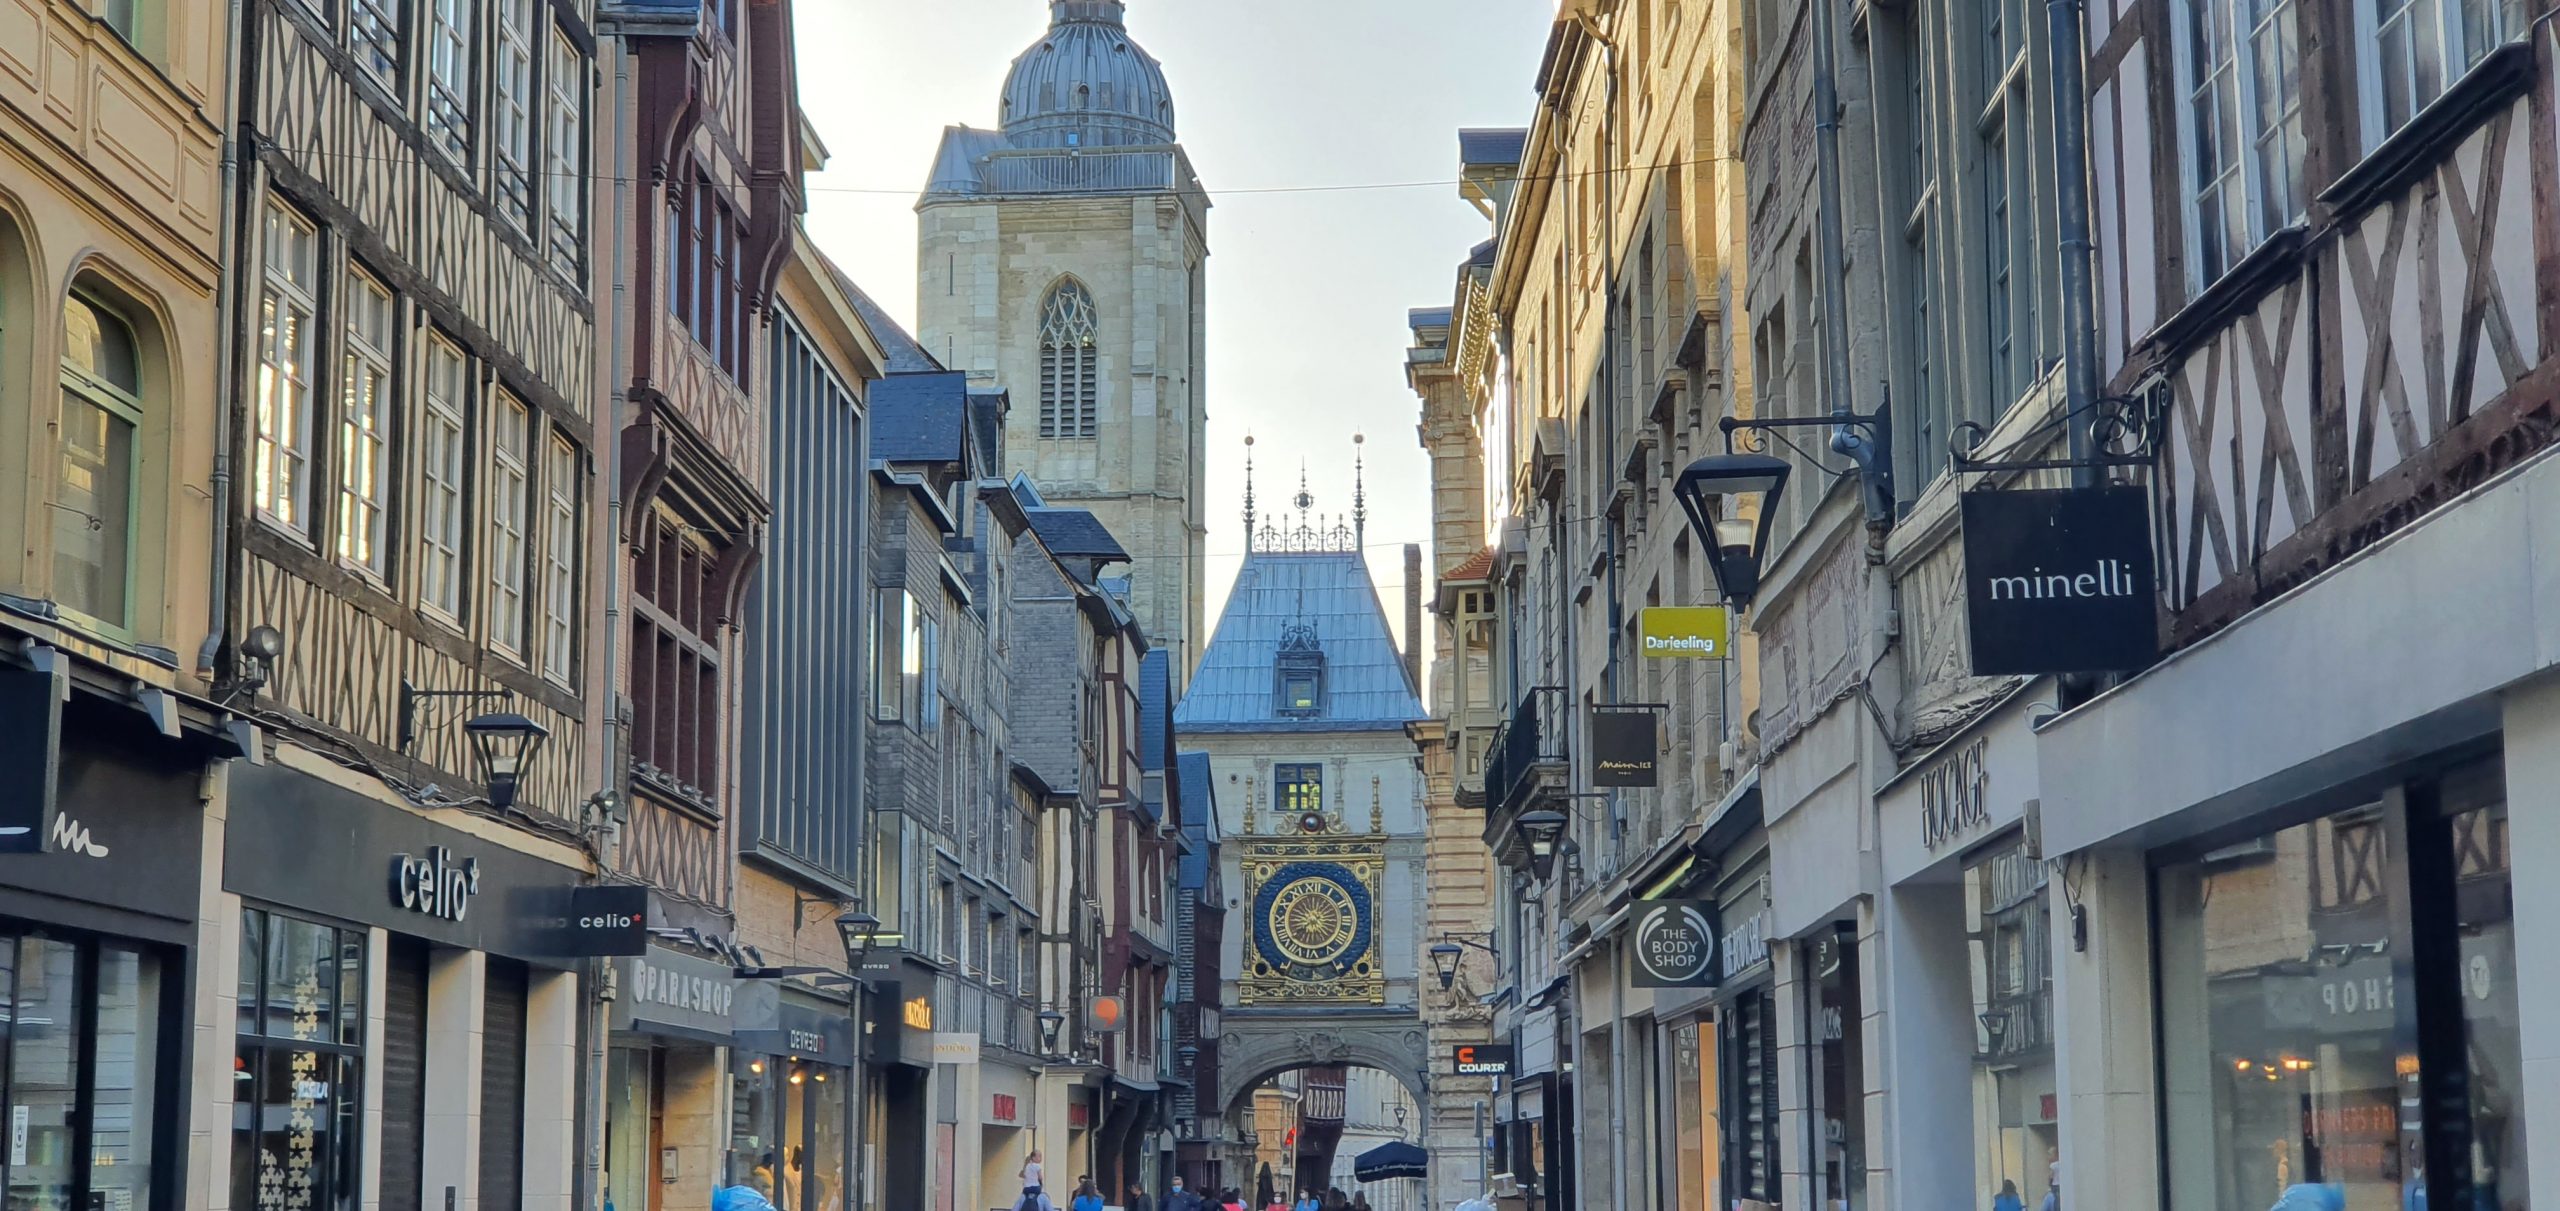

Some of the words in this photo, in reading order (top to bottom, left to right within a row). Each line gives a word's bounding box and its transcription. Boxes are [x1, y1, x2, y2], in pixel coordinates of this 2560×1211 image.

[1989, 558, 2135, 601] minelli
[1646, 635, 1714, 652] Darjeeling
[1661, 928, 1687, 939] THE
[1652, 941, 1699, 954] BODY
[1655, 955, 1697, 967] SHOP
[646, 966, 732, 1016] PARASHOP
[1458, 1063, 1506, 1073] COURIR
